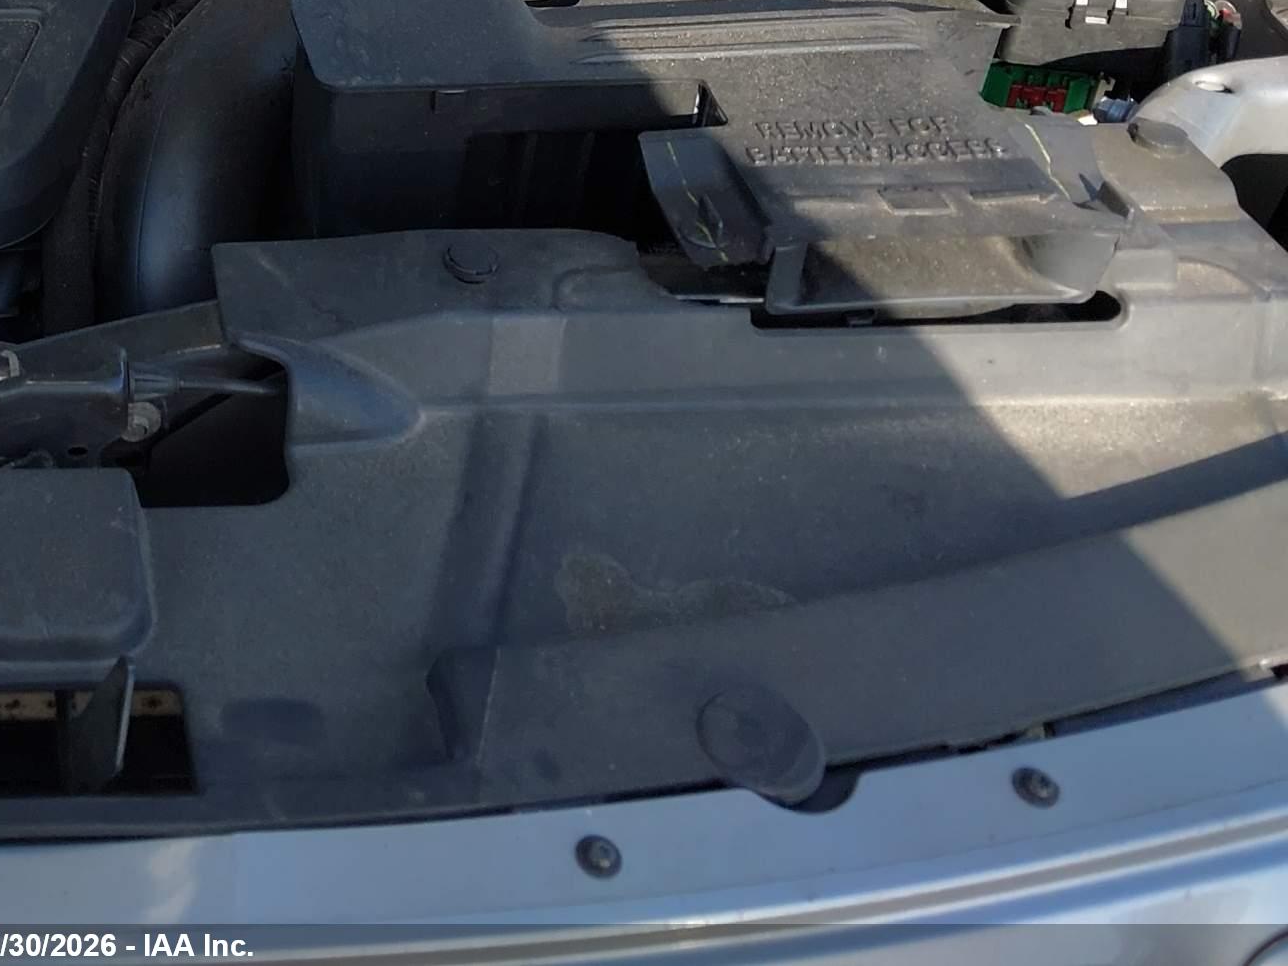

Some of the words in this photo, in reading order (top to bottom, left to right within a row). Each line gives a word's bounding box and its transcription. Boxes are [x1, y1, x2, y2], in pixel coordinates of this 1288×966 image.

[754, 119, 887, 140] REMOVE
[888, 115, 956, 137] FOR
[745, 143, 881, 167] BATTERY
[887, 137, 1007, 164] ACCESS
